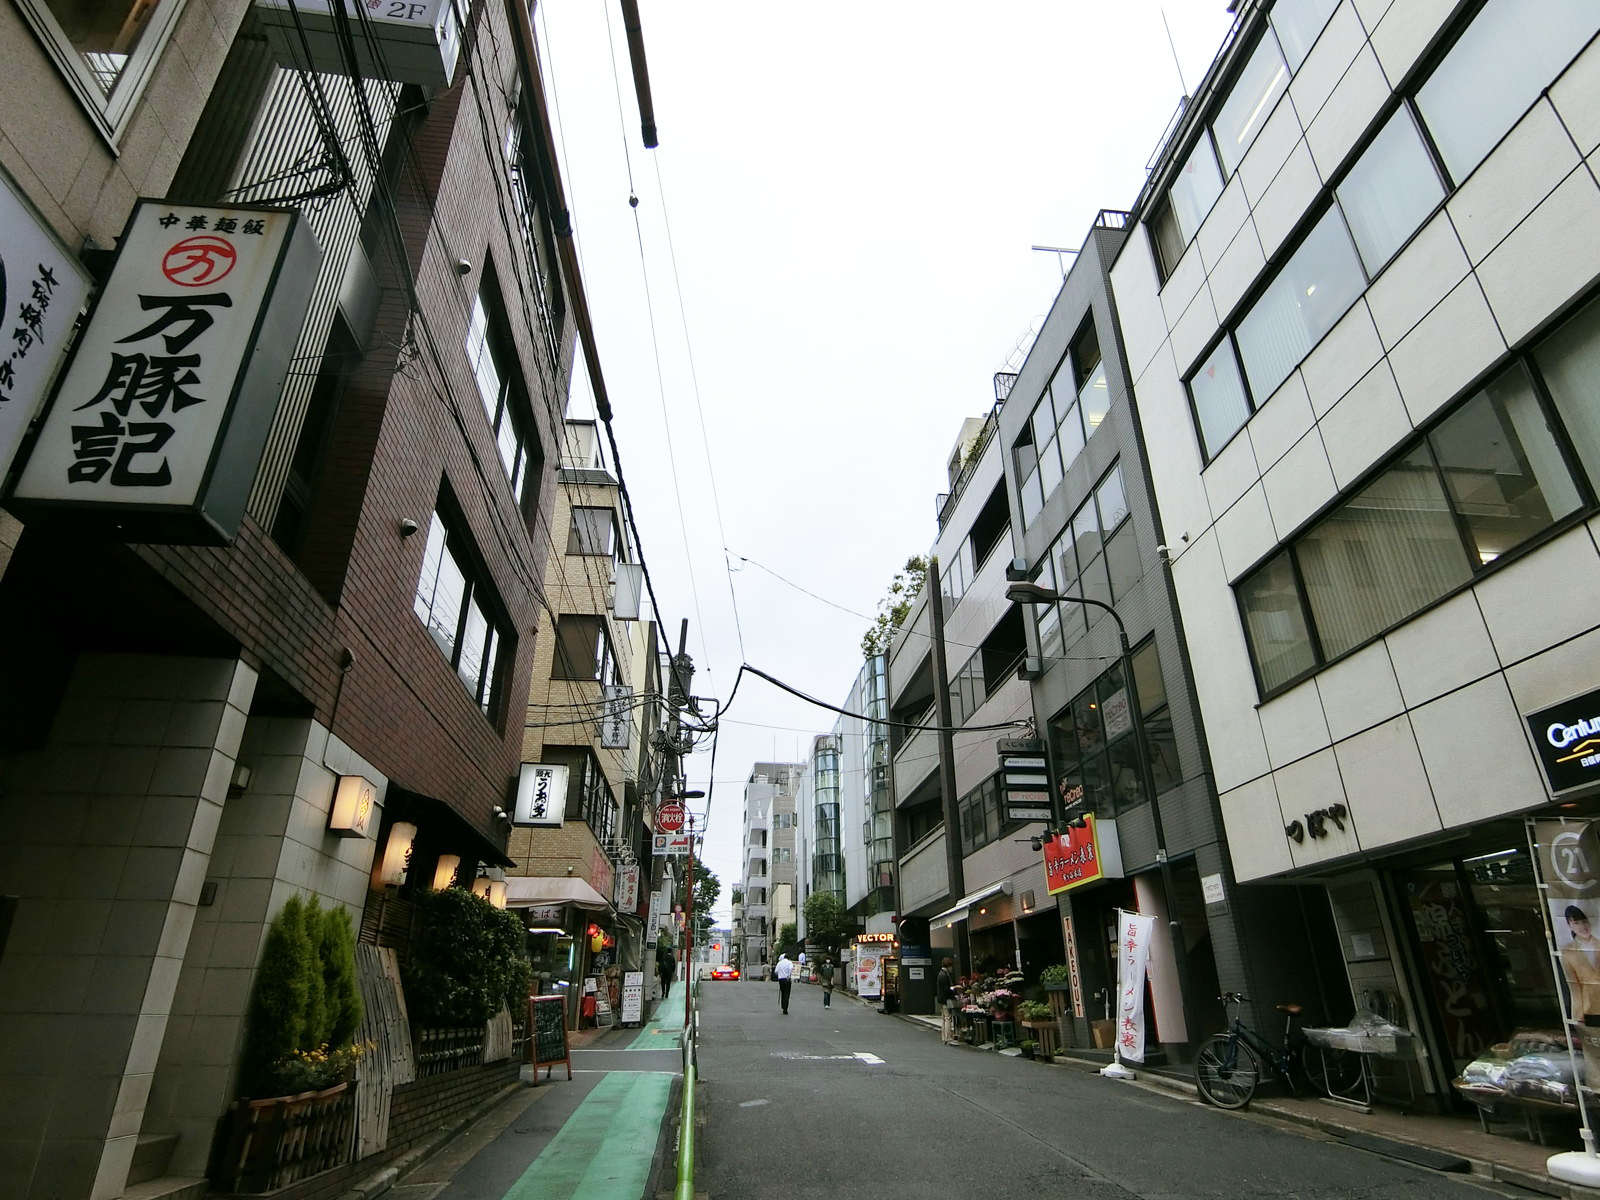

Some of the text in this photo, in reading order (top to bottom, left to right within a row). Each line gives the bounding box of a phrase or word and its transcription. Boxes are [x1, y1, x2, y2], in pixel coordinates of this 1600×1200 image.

[387, 1, 428, 20] 2F
[68, 292, 233, 488] 万豚記
[661, 812, 683, 823] 消火栓
[1561, 848, 1590, 874] 21
[857, 933, 895, 943] VECTOR
